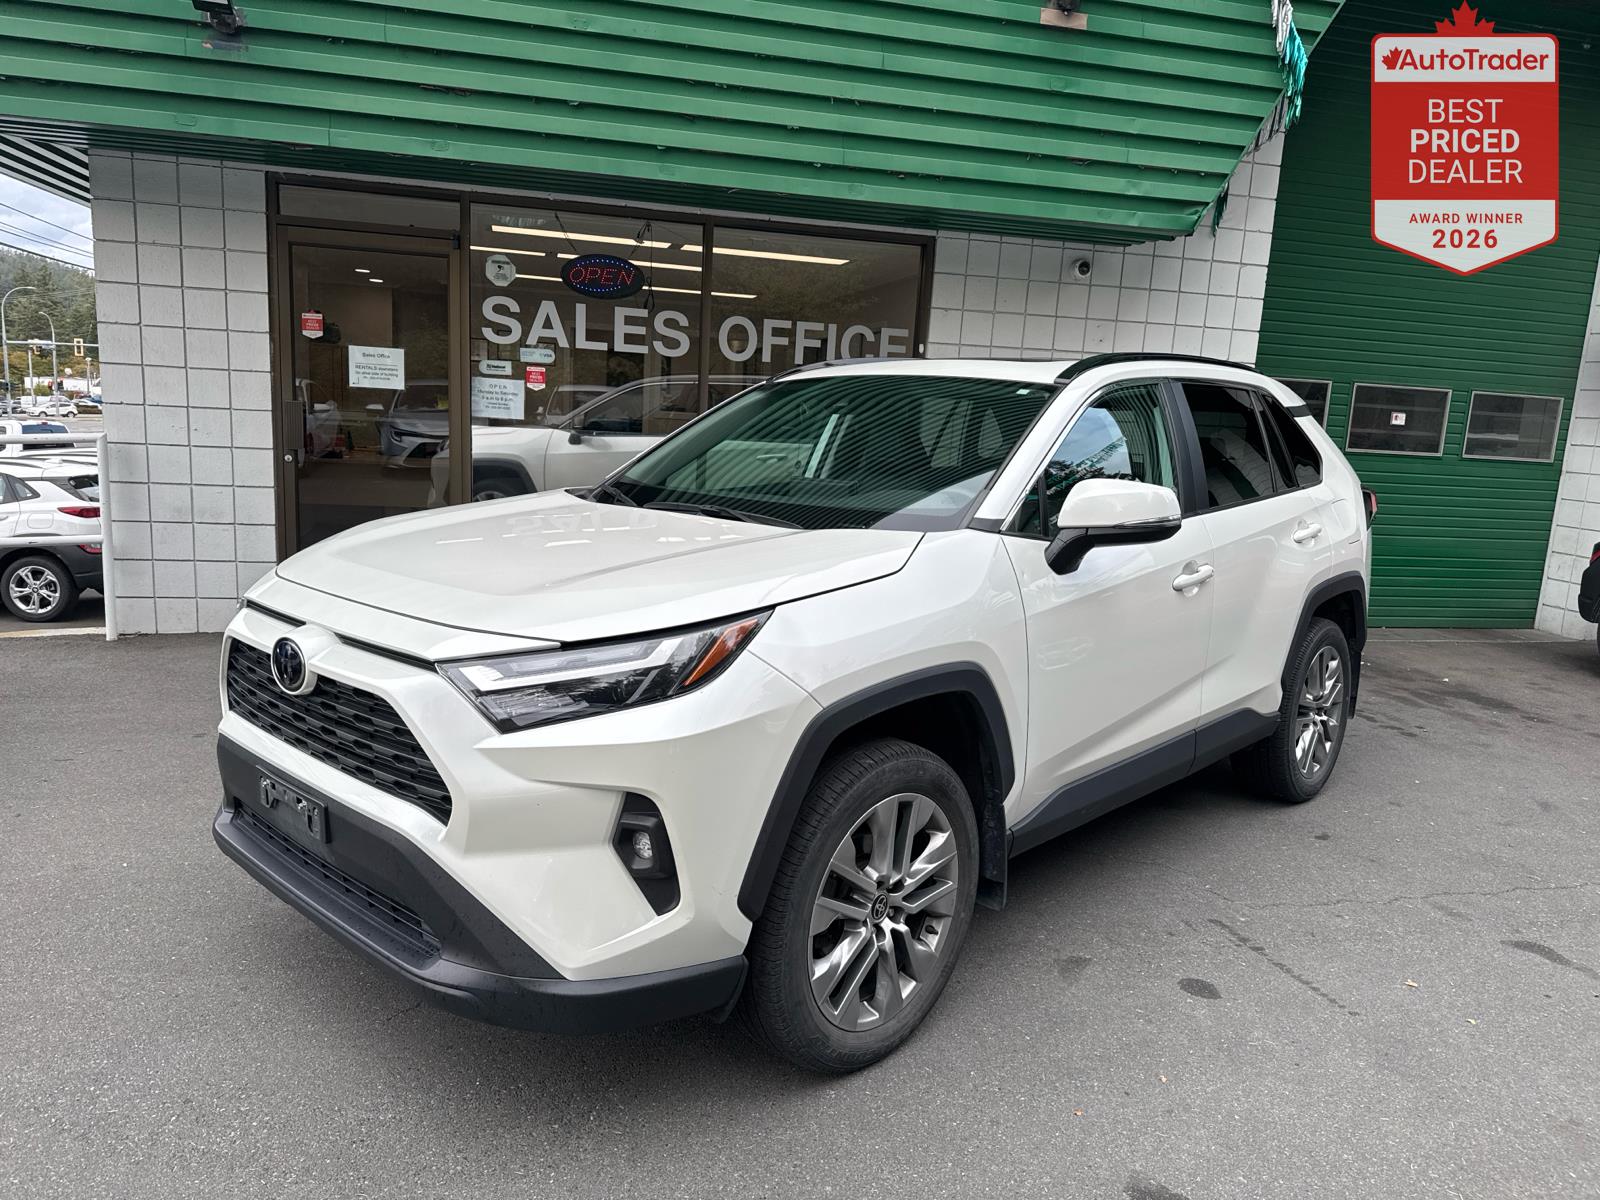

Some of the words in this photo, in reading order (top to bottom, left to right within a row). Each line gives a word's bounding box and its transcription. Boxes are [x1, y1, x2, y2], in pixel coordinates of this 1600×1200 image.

[568, 266, 635, 286] OPEN
[481, 295, 691, 358] SALES
[718, 315, 909, 365] OFFICE
